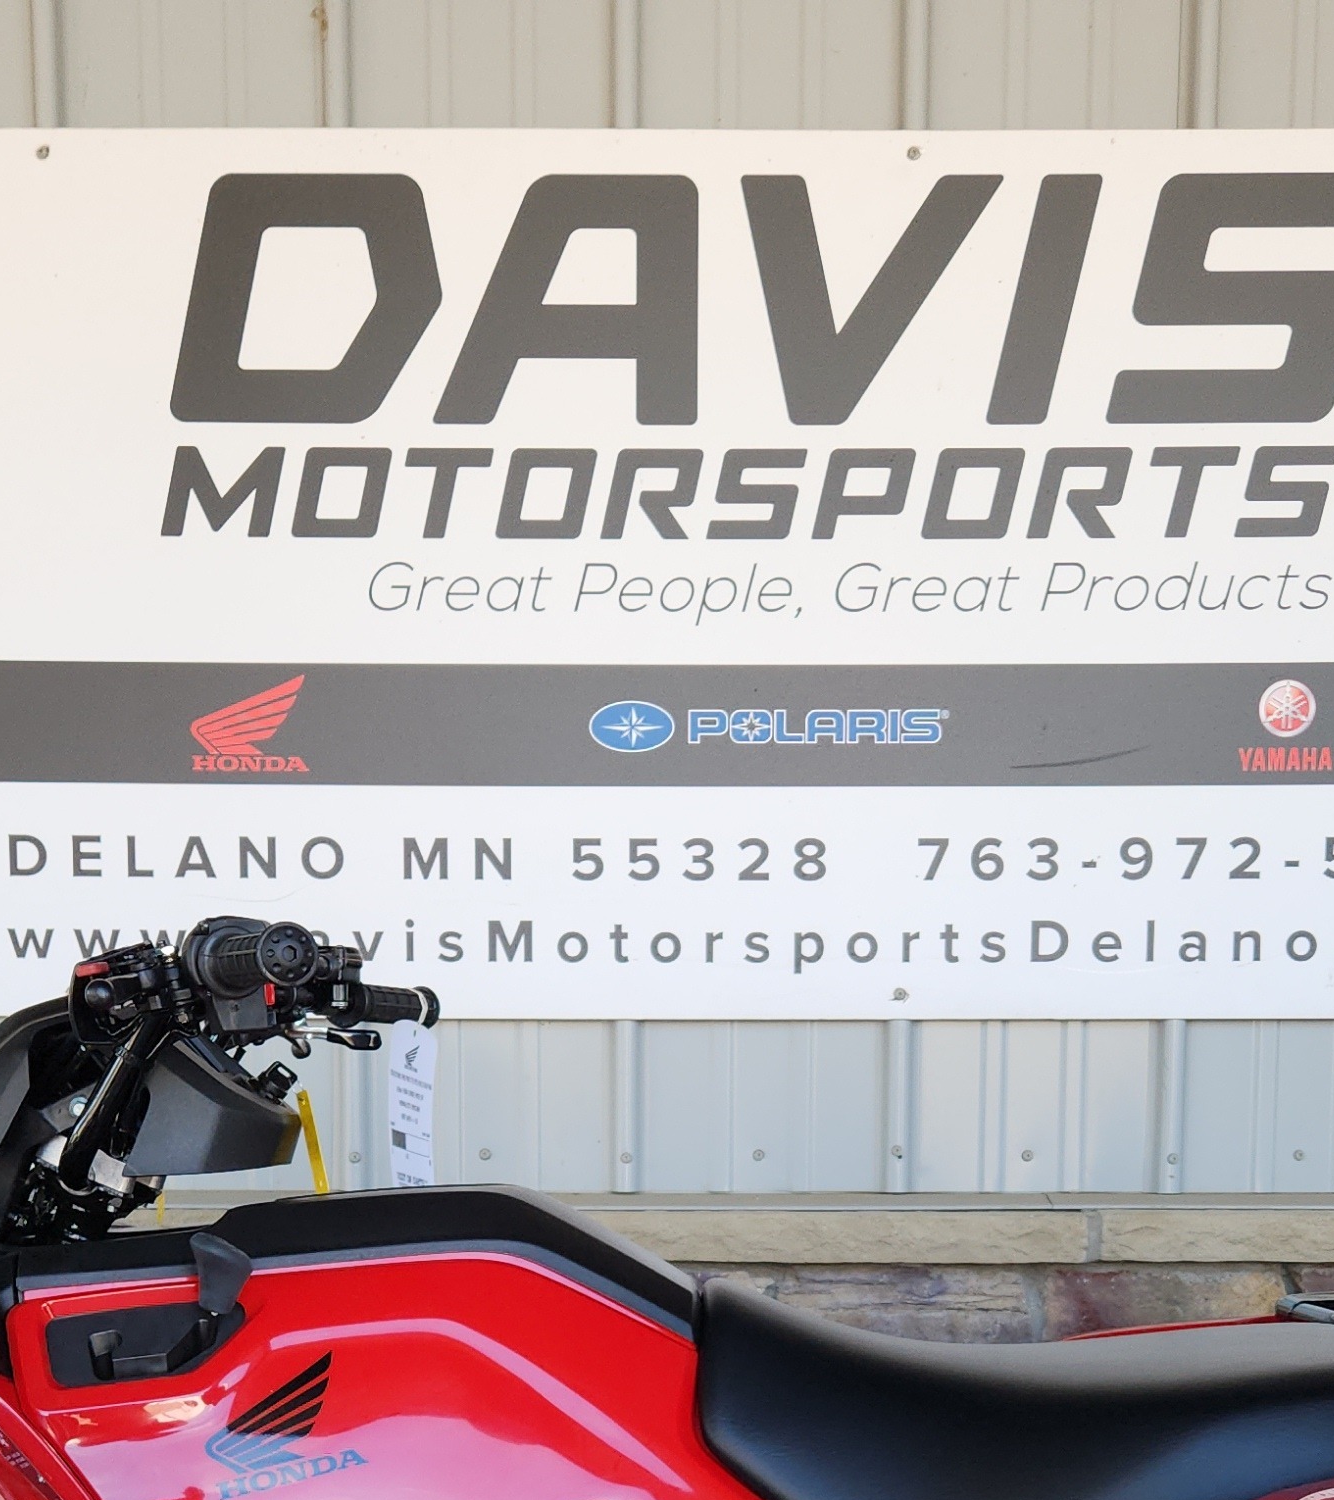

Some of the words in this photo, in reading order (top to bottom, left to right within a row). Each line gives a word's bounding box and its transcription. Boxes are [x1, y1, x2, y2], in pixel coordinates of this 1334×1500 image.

[369, 563, 553, 613] Great
[576, 563, 803, 629] People,
[836, 563, 1021, 614] Great
[1041, 562, 1333, 613] Products
[687, 708, 943, 745] POLARIS
[191, 754, 310, 773] HONDA
[1237, 746, 1333, 772] YAMAHA
[9, 835, 345, 881] DELANO
[404, 838, 513, 882] MN
[573, 838, 828, 883] 55328
[216, 1448, 369, 1500] HONDA
